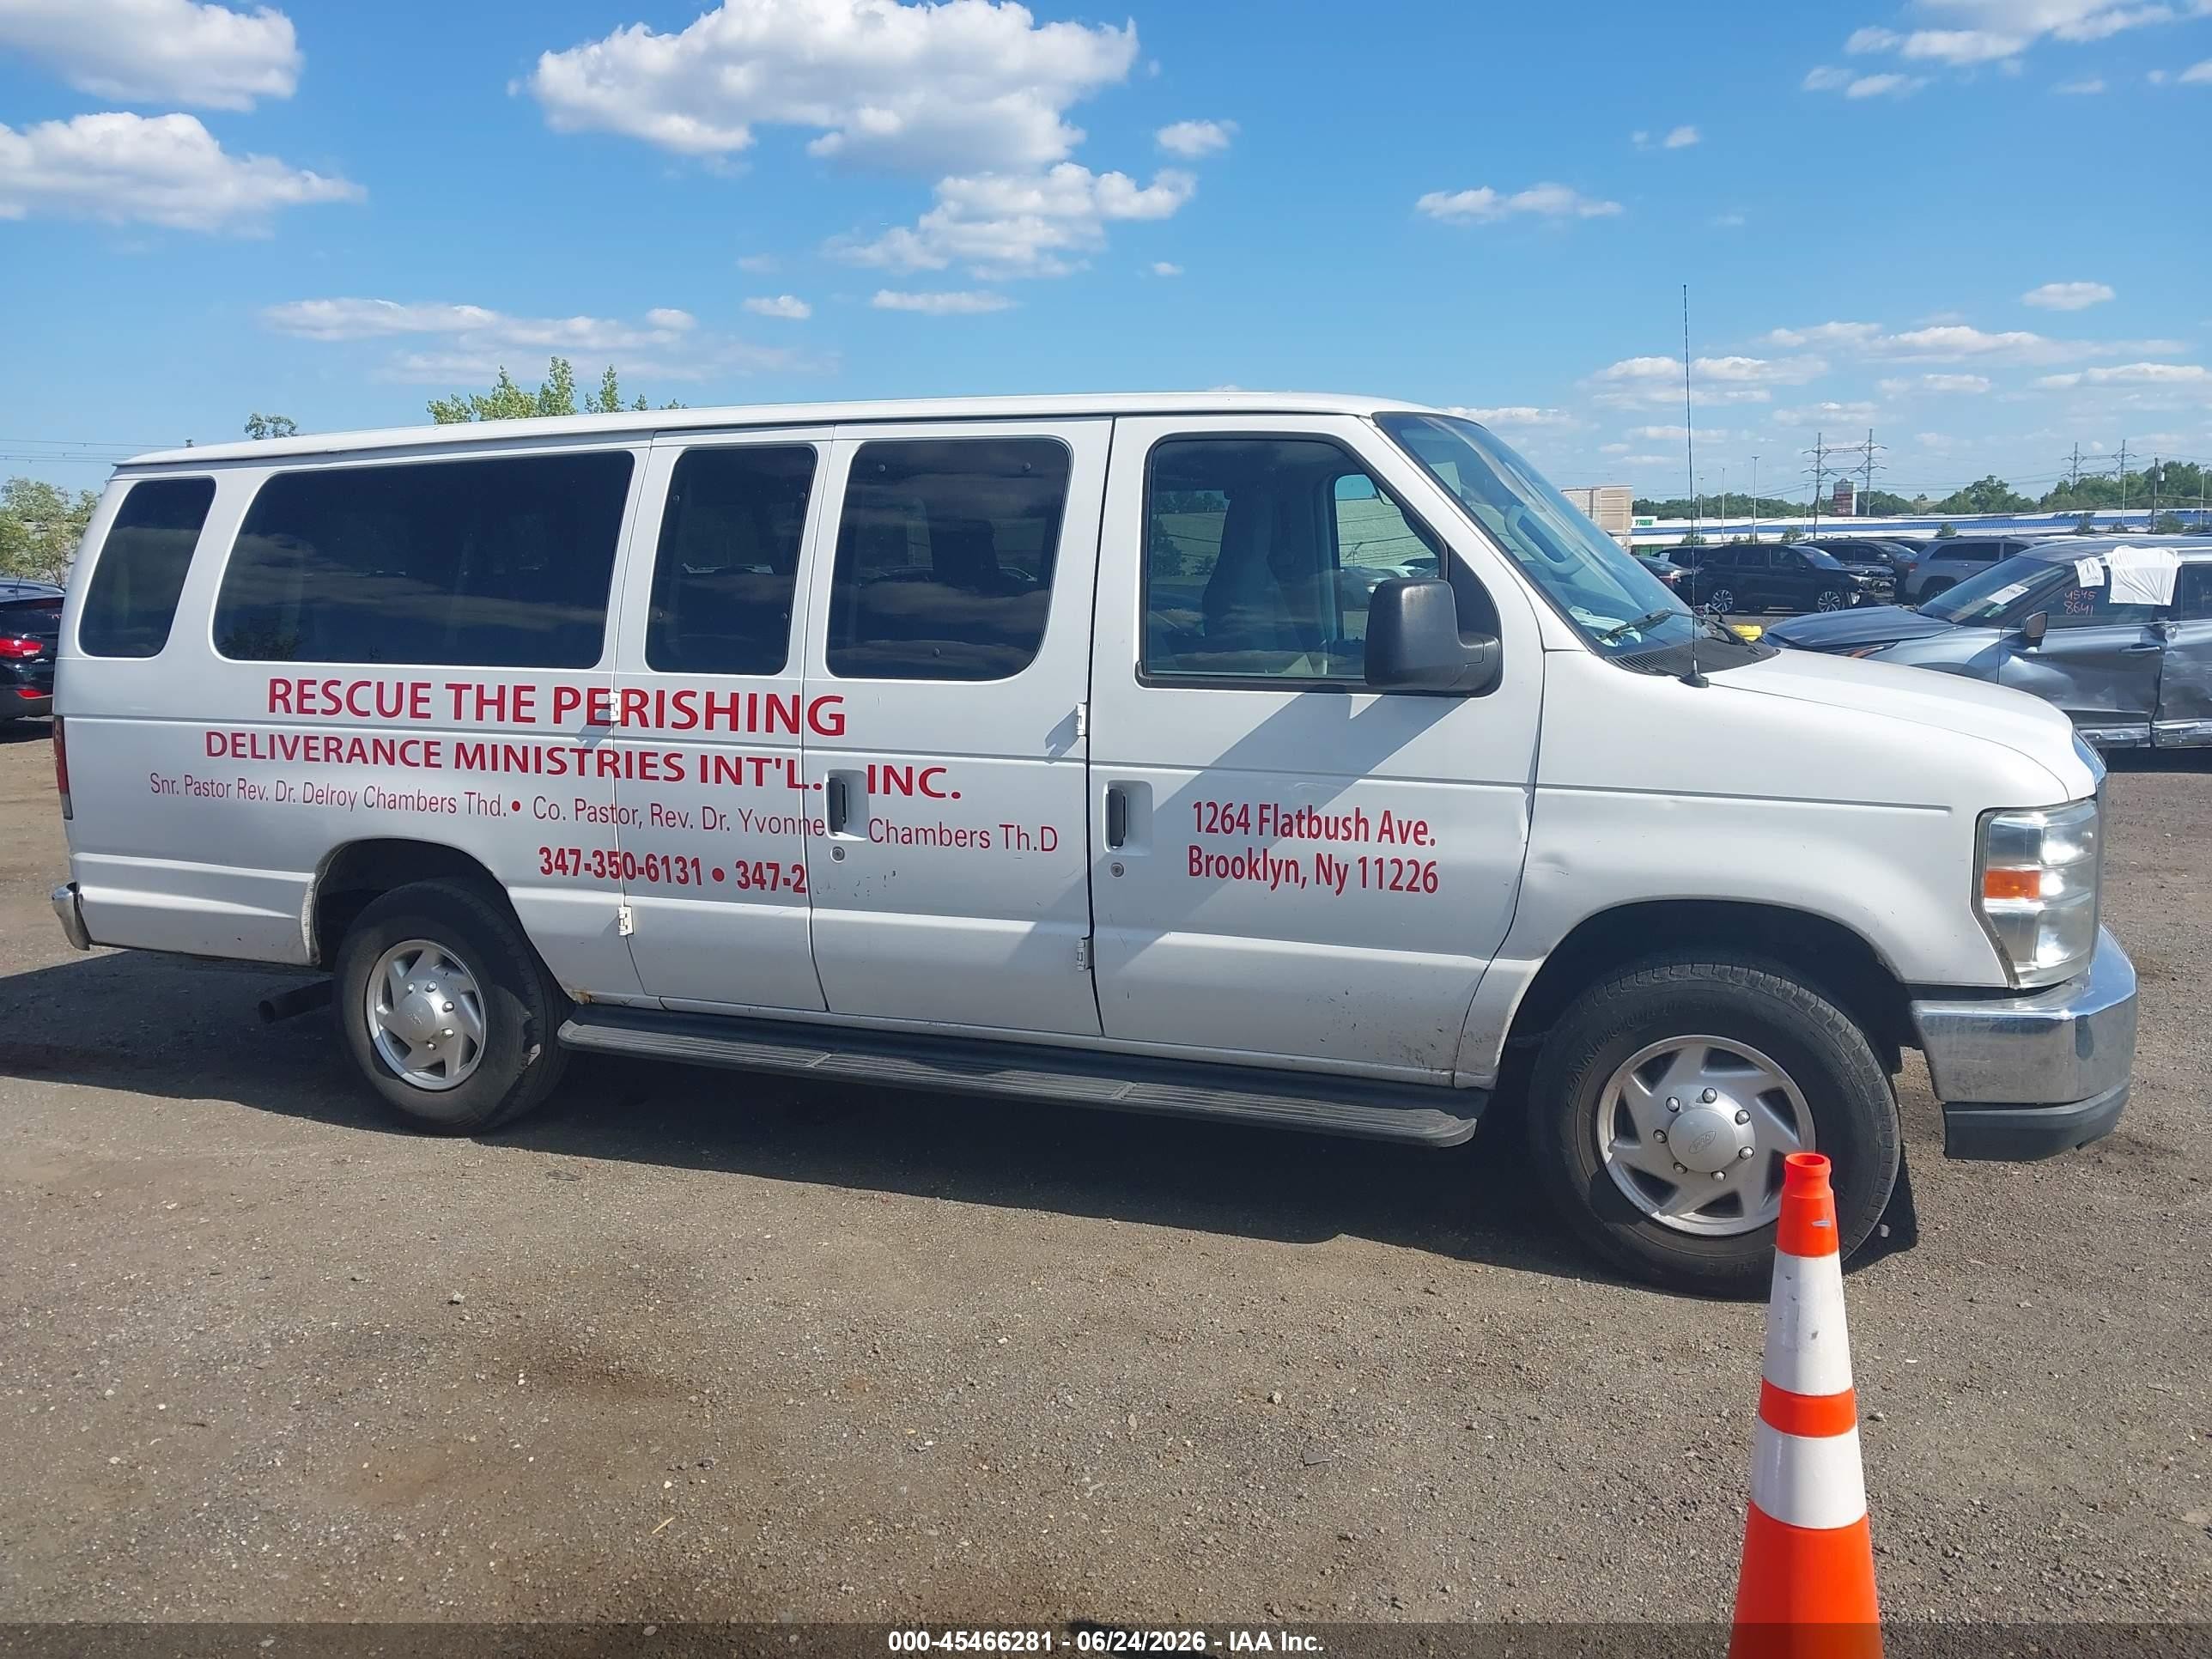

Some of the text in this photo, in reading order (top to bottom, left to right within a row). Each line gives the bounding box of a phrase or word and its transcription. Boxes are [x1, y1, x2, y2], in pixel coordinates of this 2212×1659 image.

[268, 678, 846, 737] RESCUE THE PERISHING
[205, 731, 962, 800] DELIVERANCE MINISTRIES INT'L. INC.
[149, 773, 1059, 854] Snr. Pastor Rev. Dr. Delroy Chambers Thd. Co. Pastor, Rev. Dr. Yvonne Chambers Th.D
[1193, 801, 1436, 847] 1264 Flatbush Ave.
[538, 846, 807, 894] 347-350-6131 347-2
[1188, 844, 1438, 896] Brooklyn, Ny 11226
